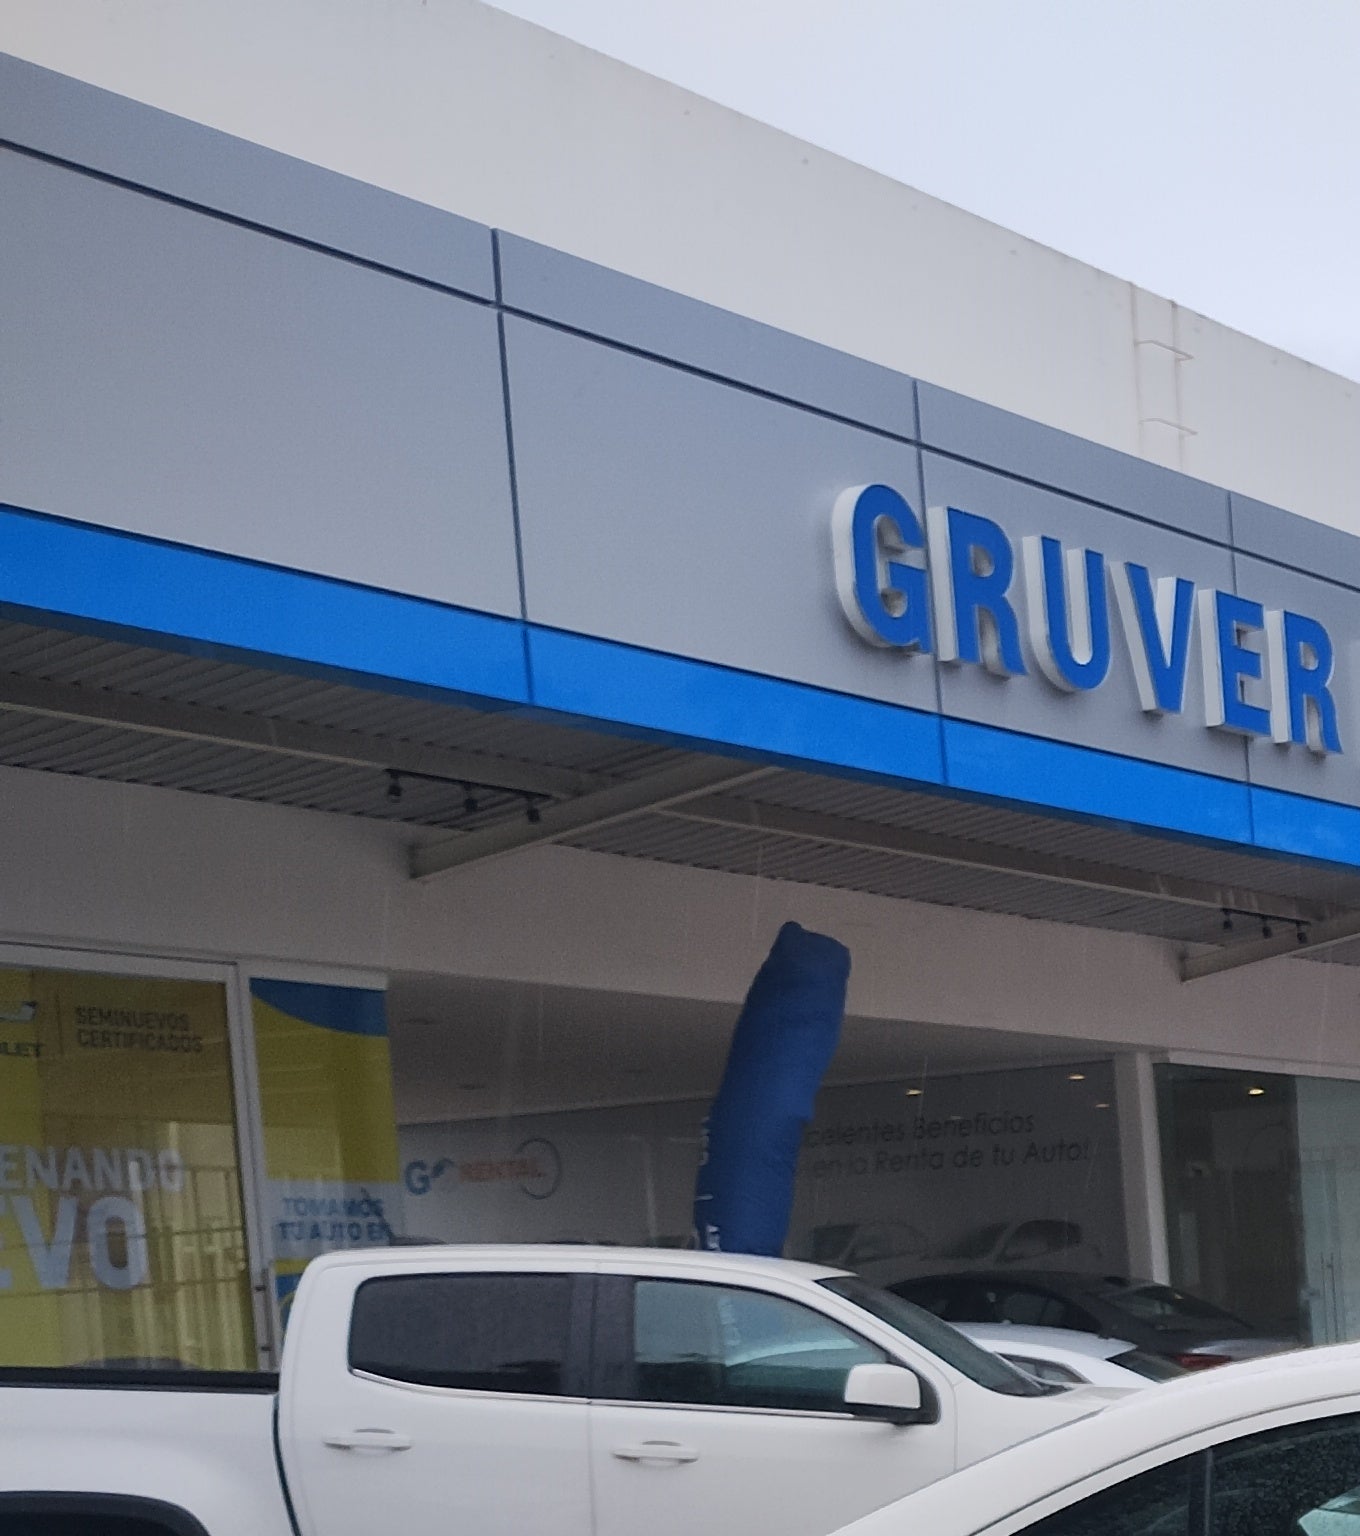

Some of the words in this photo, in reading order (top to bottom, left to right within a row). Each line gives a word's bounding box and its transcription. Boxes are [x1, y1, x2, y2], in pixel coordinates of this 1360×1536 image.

[832, 483, 1342, 755] GRUVER
[75, 1006, 190, 1031] SEMINUEVOS
[0, 1042, 47, 1058] LET
[77, 1028, 203, 1053] CERTIFICADOS
[803, 1122, 906, 1148] celentes
[913, 1111, 1036, 1141] Beneficios
[874, 1147, 945, 1174] Renta
[953, 1143, 984, 1169] de
[992, 1143, 1015, 1167] tu
[0, 1196, 149, 1291] VO
